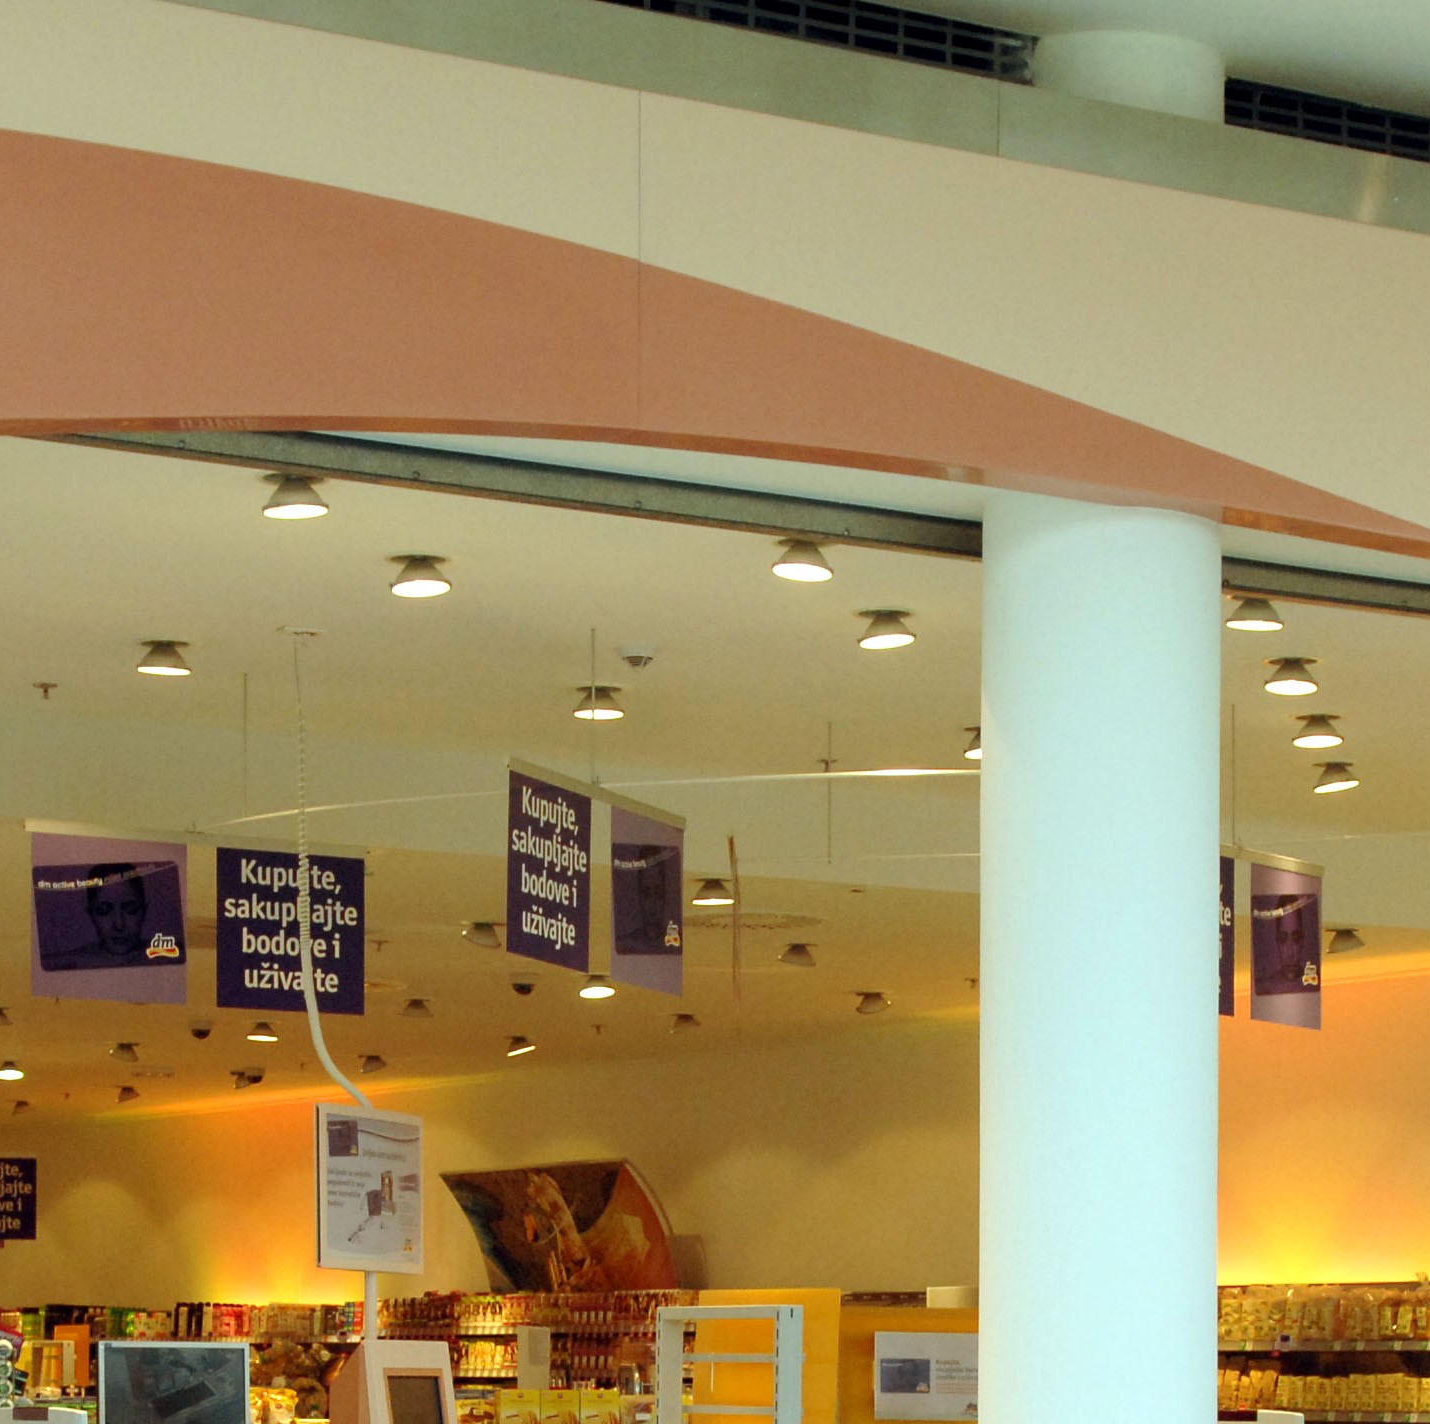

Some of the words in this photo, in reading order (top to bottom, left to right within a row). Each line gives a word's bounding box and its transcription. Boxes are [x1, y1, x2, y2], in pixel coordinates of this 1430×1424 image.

[522, 785, 579, 835] Kupujte,
[511, 826, 587, 875] sakupljajte
[240, 858, 342, 893] Kupute,
[521, 863, 569, 906] bodove
[573, 879, 578, 907] i
[224, 893, 358, 932] sakupajte
[522, 904, 575, 950] uživajte
[152, 933, 176, 950] dm
[333, 933, 340, 959] i
[244, 962, 339, 992] uživate
[17, 1199, 22, 1212] i
